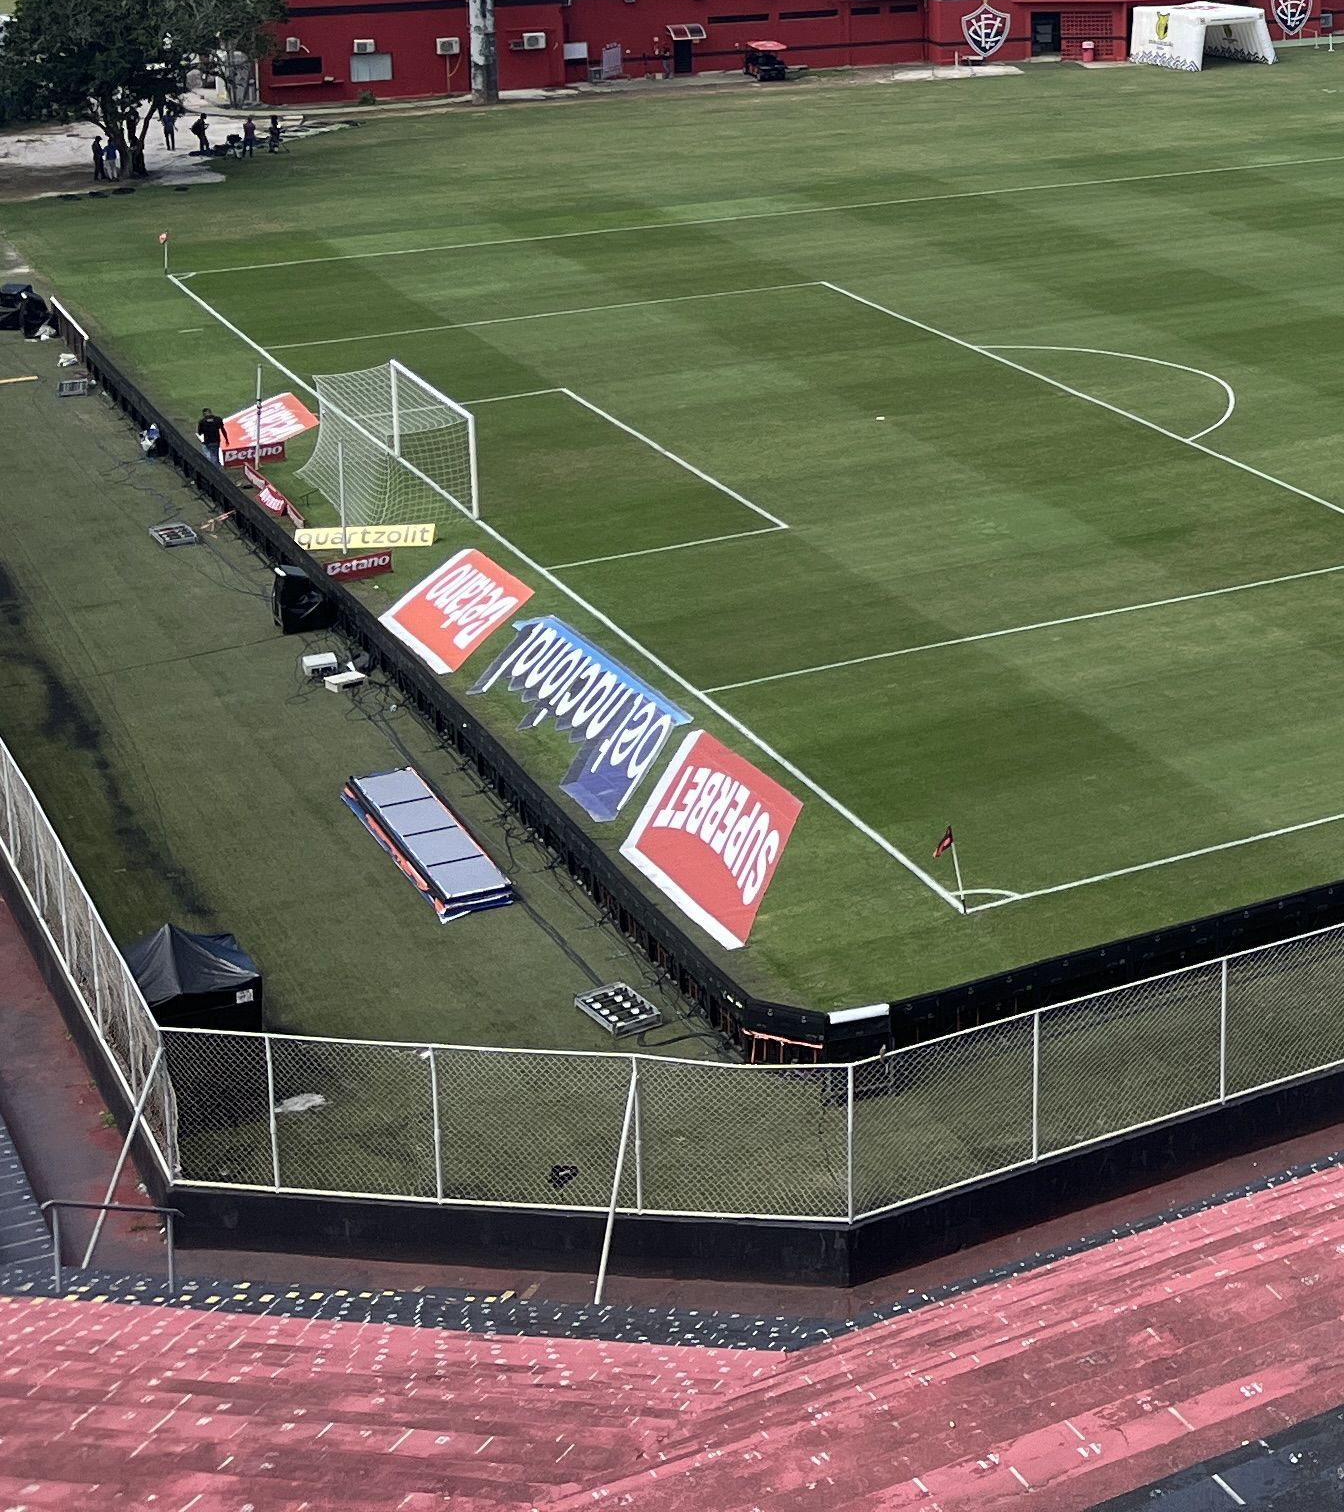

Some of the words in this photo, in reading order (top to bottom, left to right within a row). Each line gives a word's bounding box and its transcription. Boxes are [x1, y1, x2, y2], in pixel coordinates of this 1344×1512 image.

[297, 525, 431, 550] quartzolit
[326, 555, 391, 576] Betano
[425, 563, 519, 651] Betano
[482, 621, 673, 812] betnacional
[652, 765, 781, 907] SUPERBET
